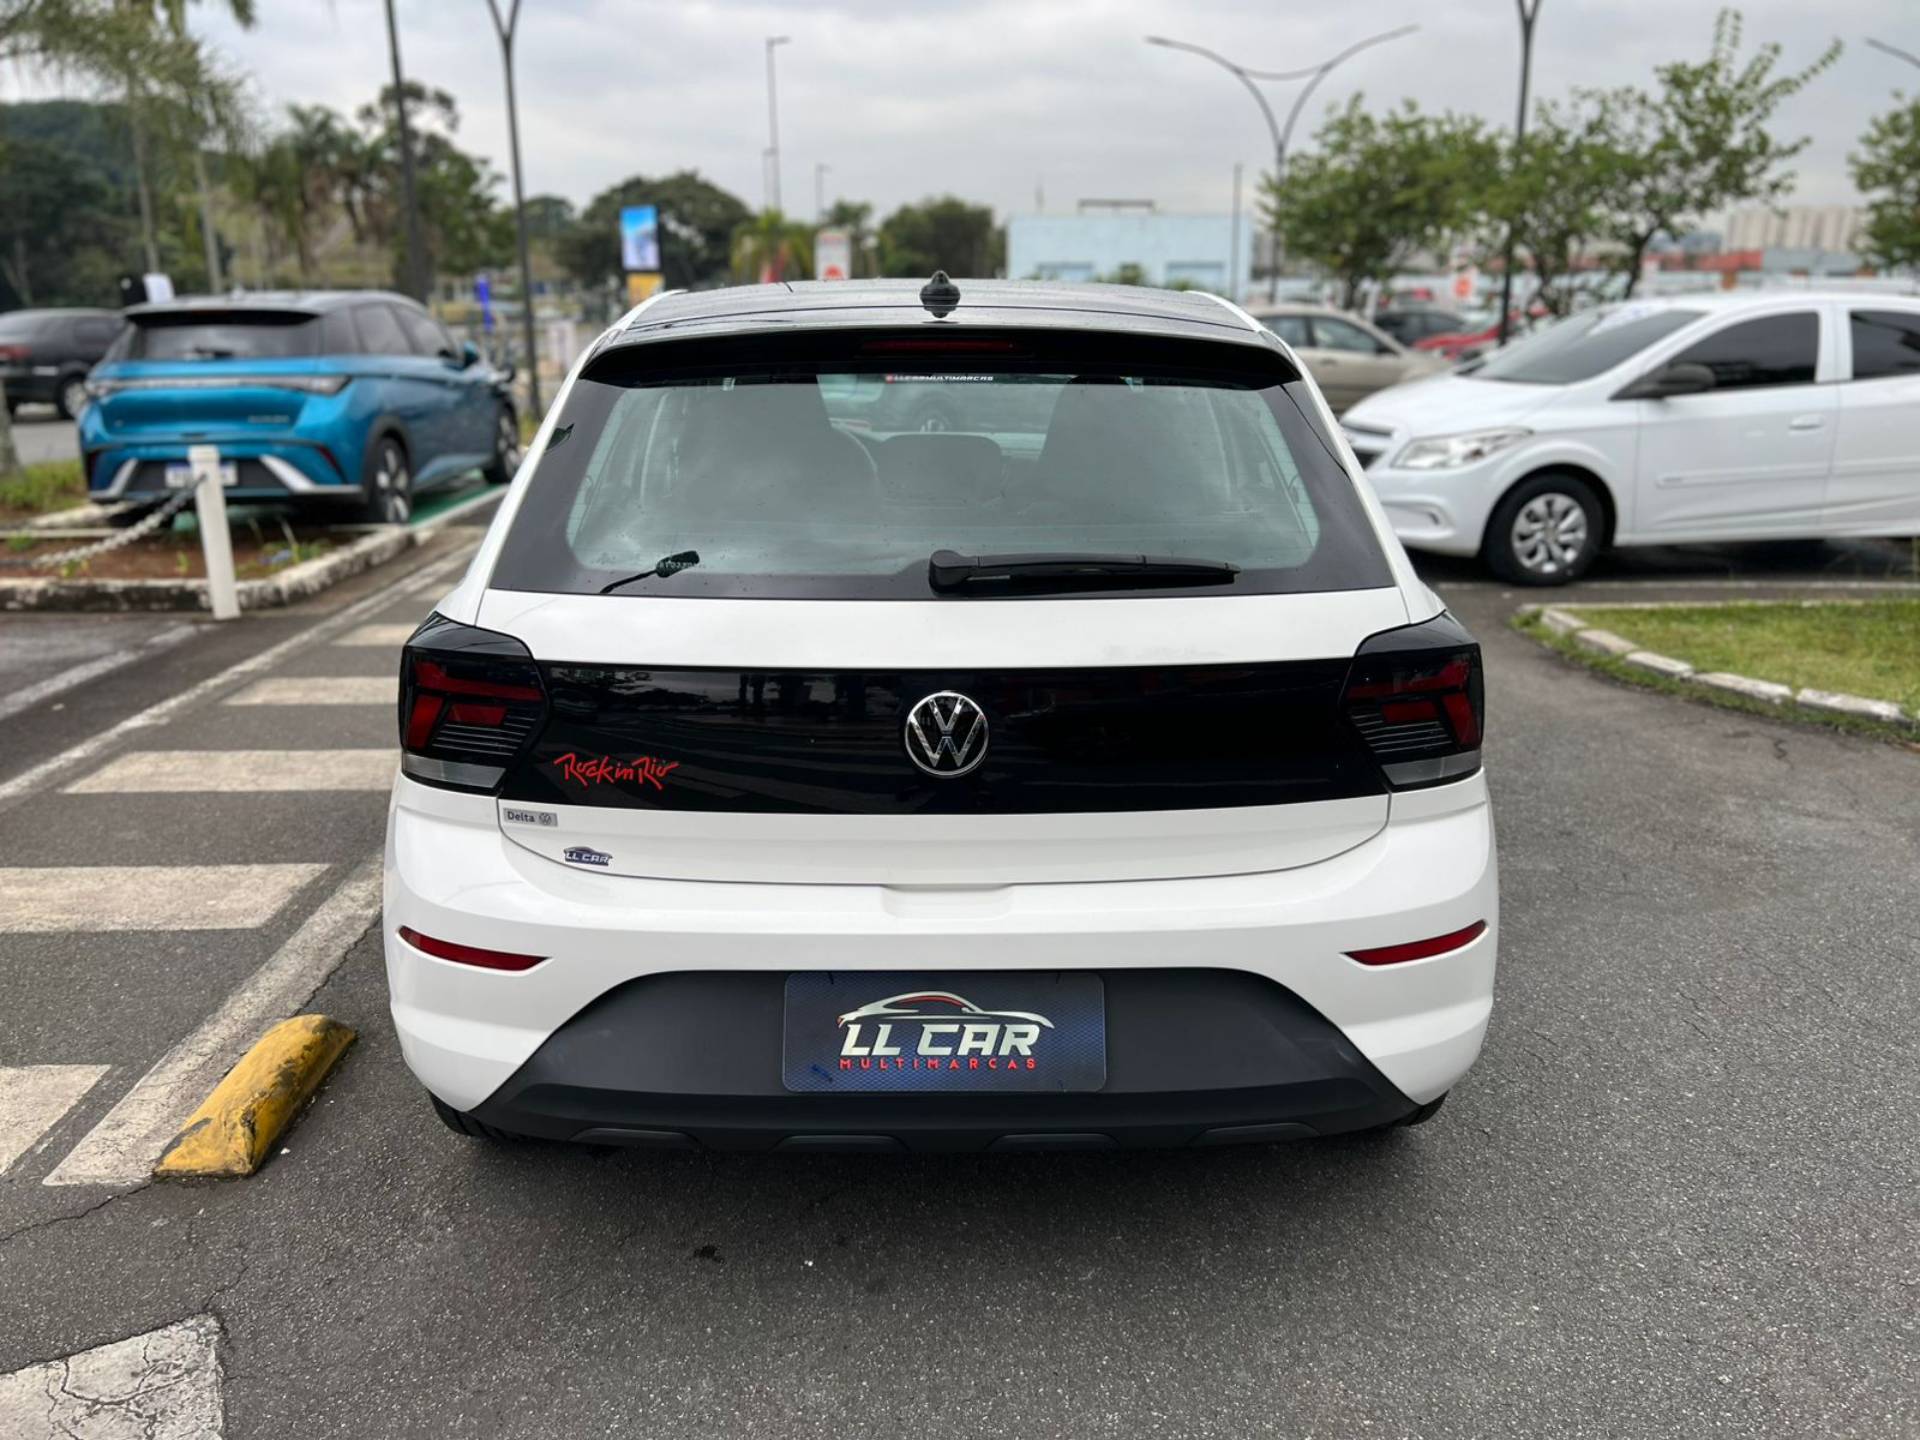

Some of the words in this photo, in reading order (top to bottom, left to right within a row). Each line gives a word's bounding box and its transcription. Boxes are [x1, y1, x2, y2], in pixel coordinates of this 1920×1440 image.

[507, 810, 536, 822] Delta
[566, 852, 579, 861] LL
[582, 854, 609, 864] CAR
[840, 1024, 902, 1056] LL
[916, 1024, 1041, 1056] CAR
[839, 1058, 1037, 1070] MULTIMARCAS
